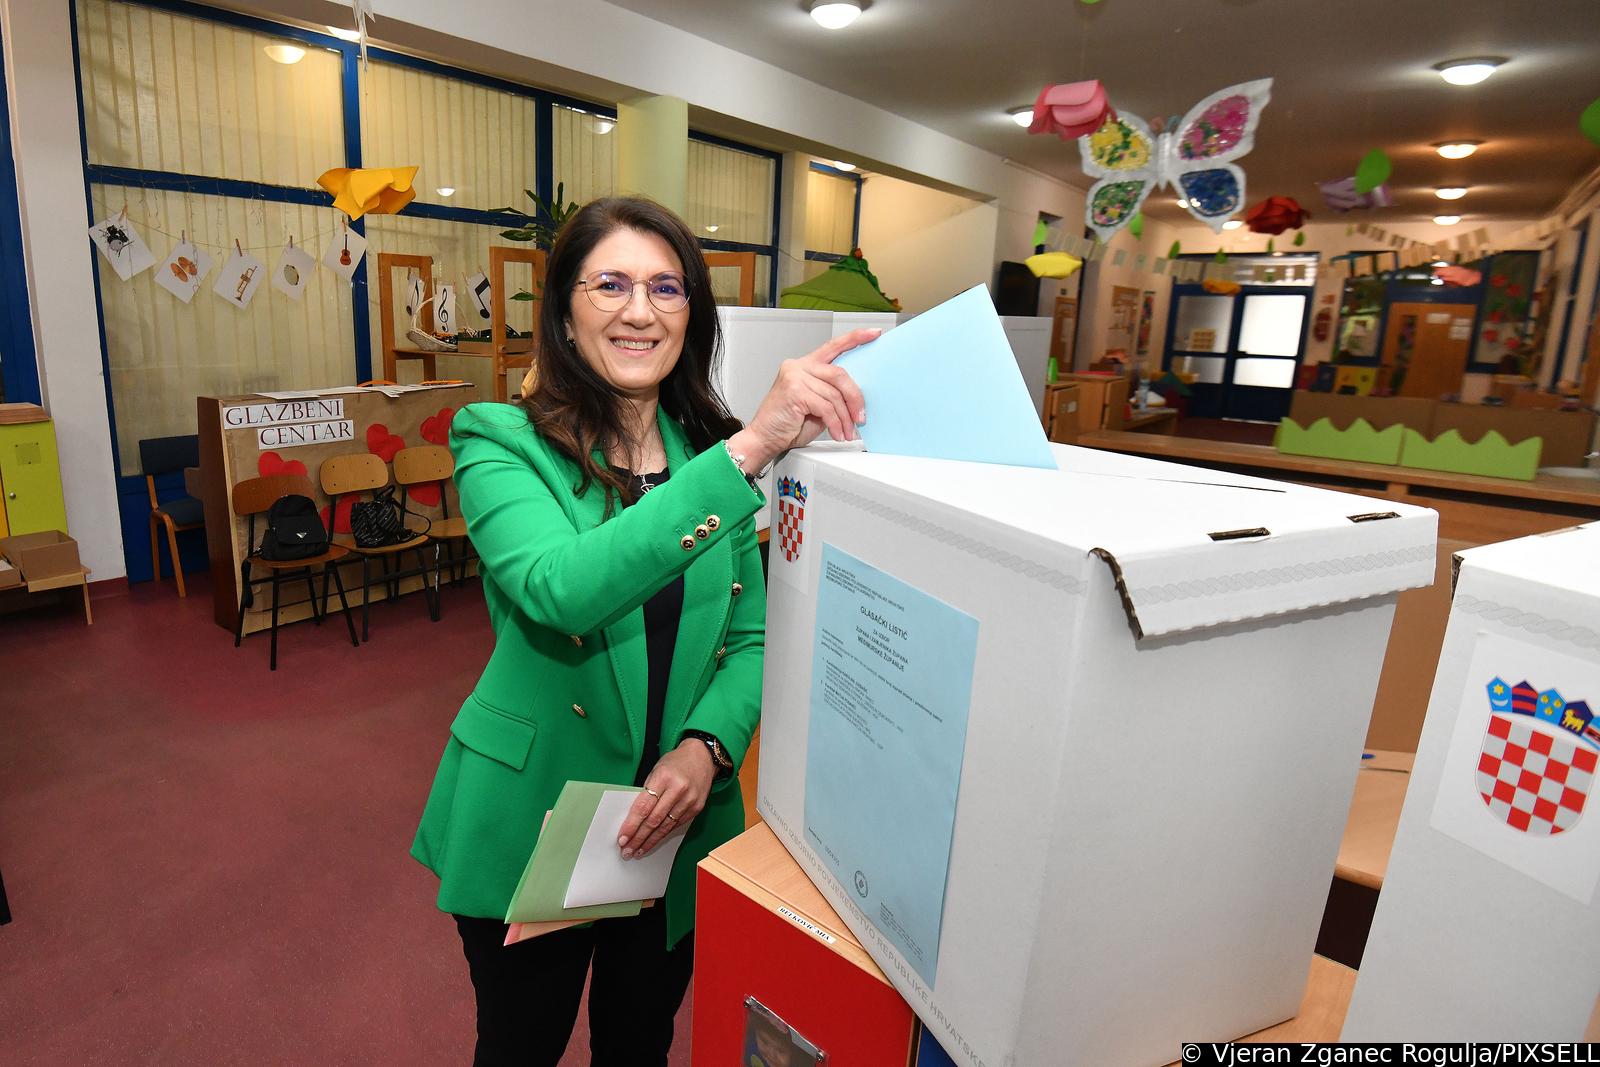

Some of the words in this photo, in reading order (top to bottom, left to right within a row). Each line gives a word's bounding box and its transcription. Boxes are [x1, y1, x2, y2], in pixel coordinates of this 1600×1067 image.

[226, 400, 342, 426] GLAZBENI
[260, 421, 352, 446] CENTAR
[817, 863, 875, 939] POVJERENSTVO
[876, 936, 929, 1004] REPUBLIKE
